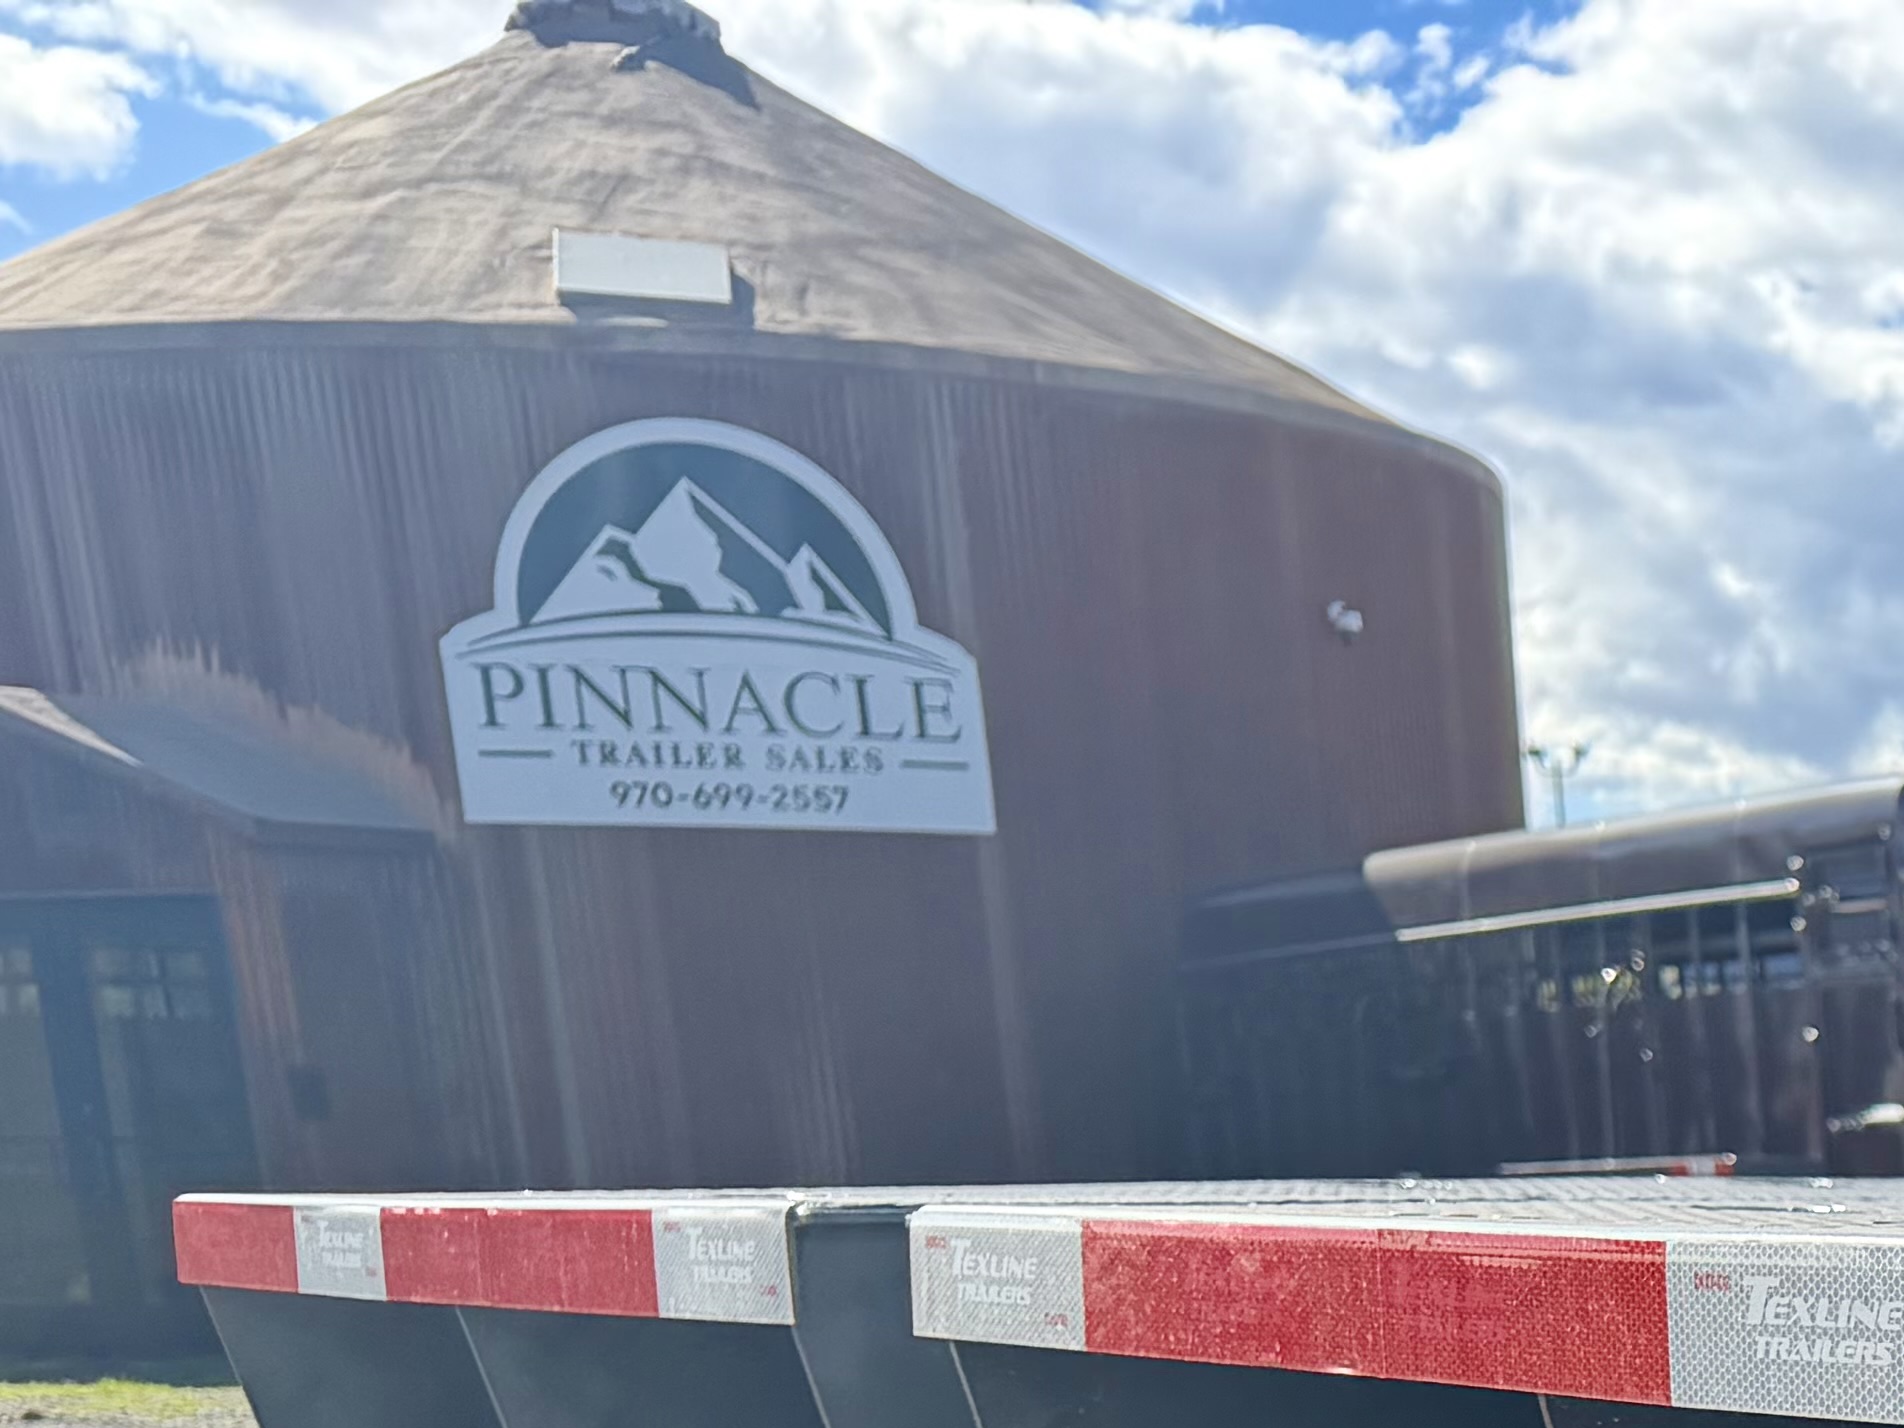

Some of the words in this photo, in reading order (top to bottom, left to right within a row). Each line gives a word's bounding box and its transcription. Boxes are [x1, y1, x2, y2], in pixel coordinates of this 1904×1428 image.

[470, 661, 963, 745] PINNACLE
[570, 738, 746, 771] TRAILER
[765, 742, 884, 777] SALES
[609, 780, 849, 814] 970-699-2557
[685, 1226, 756, 1261] TEXLINE
[950, 1237, 1039, 1279] TEXLINE
[957, 1281, 1032, 1306] TRAILERS
[1740, 1274, 1904, 1332] TEXLINE
[1756, 1335, 1894, 1368] TRAILERS
